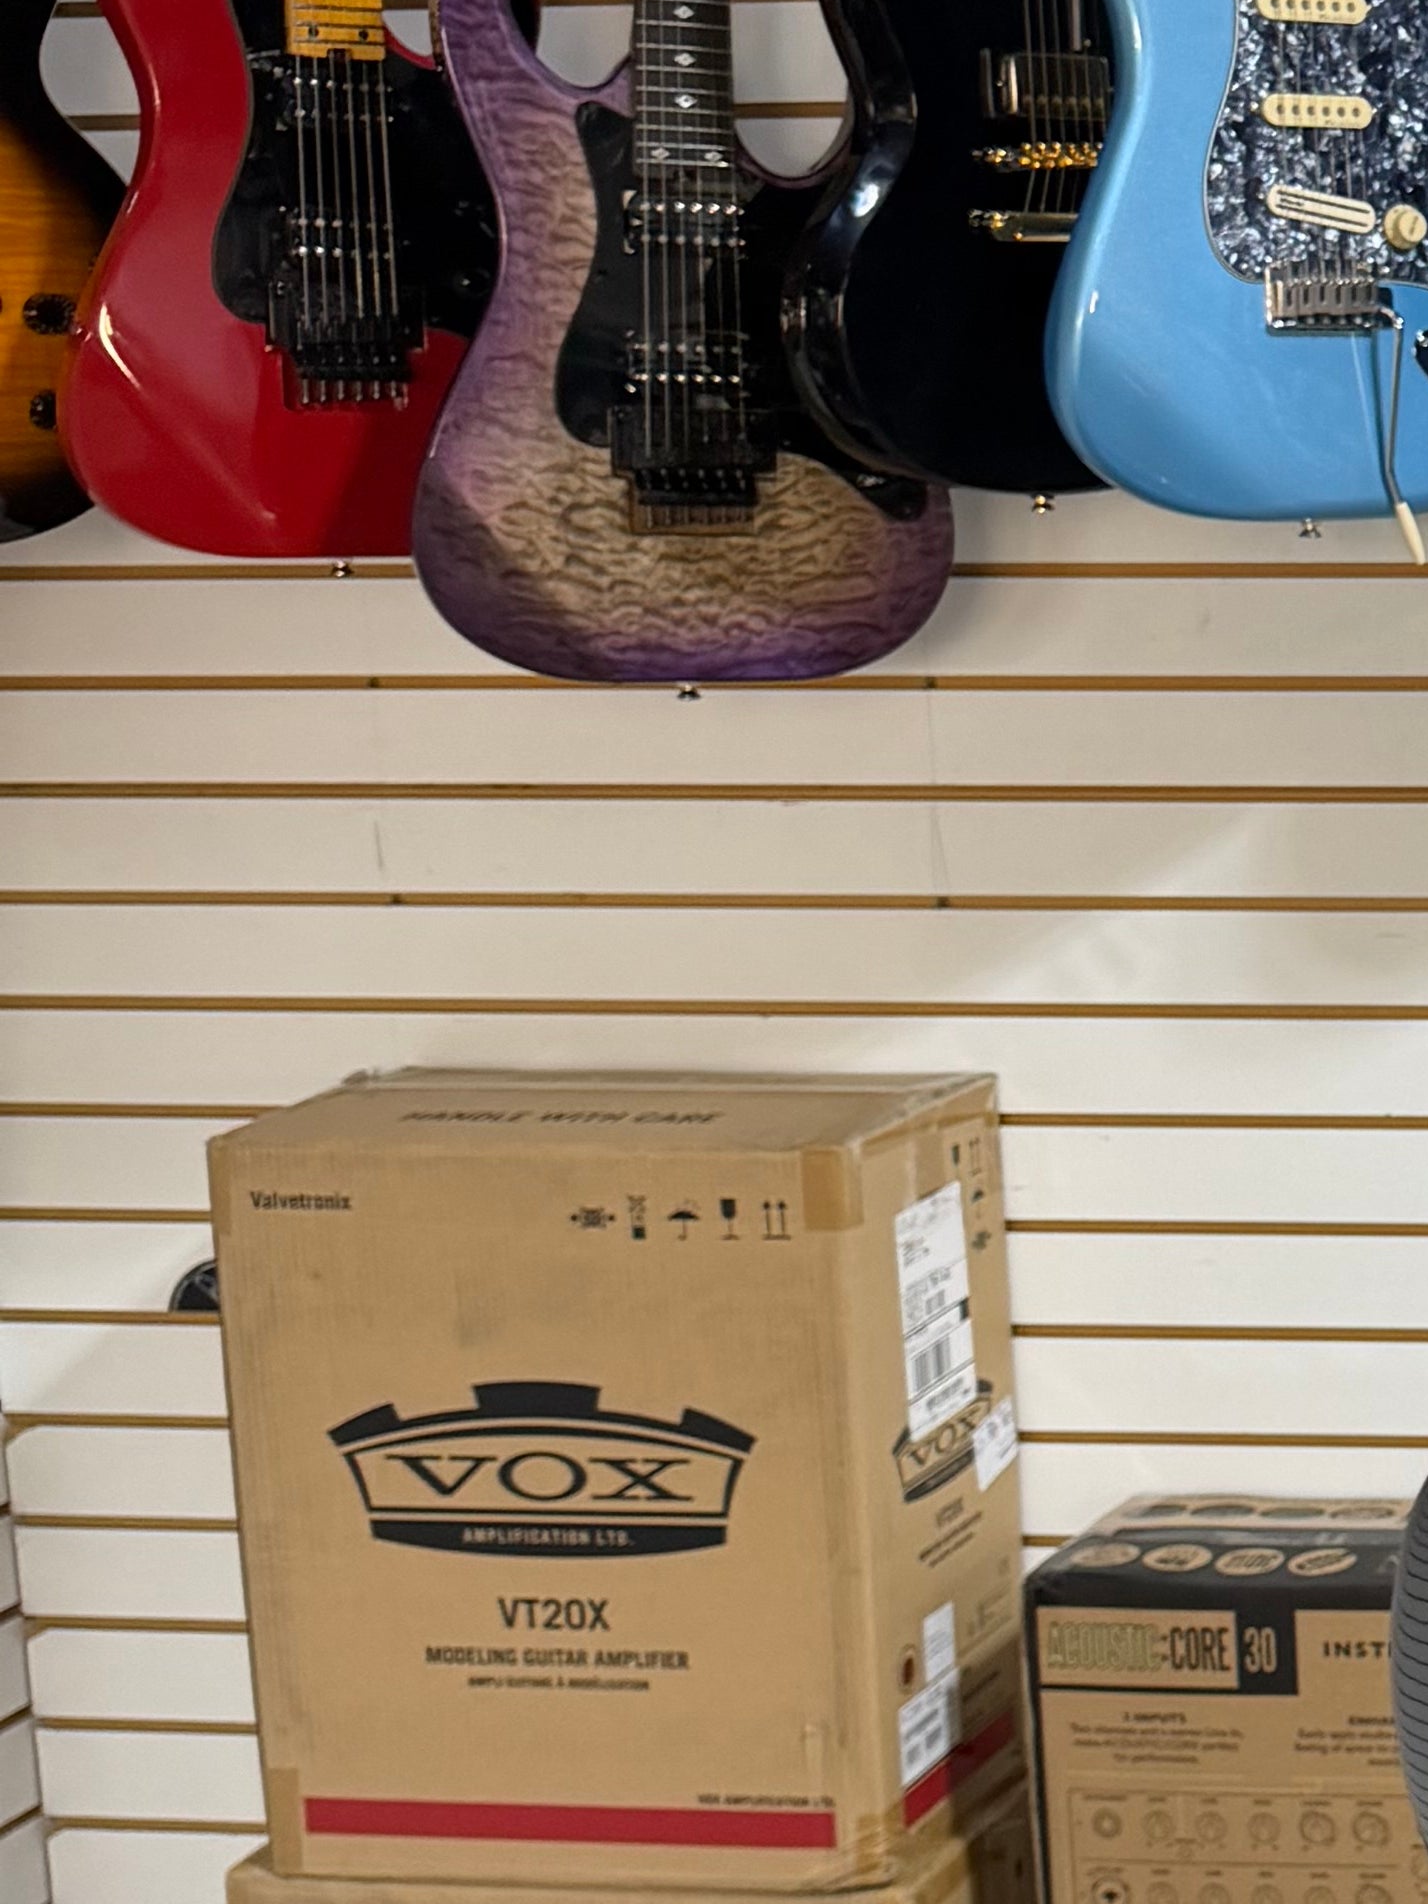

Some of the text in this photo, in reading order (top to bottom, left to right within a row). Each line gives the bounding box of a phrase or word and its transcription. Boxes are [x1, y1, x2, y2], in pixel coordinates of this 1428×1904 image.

[400, 1109, 724, 1126] HANDLE WITH CARE
[249, 1189, 353, 1213] Valvetronix
[384, 1450, 694, 1503] VOX
[461, 1526, 637, 1548] AMPLIFICATION LTD.
[496, 1596, 611, 1632] VT20X
[424, 1645, 691, 1671] MODELING GUITAR AMPLIFIER
[1243, 1626, 1278, 1674] 30
